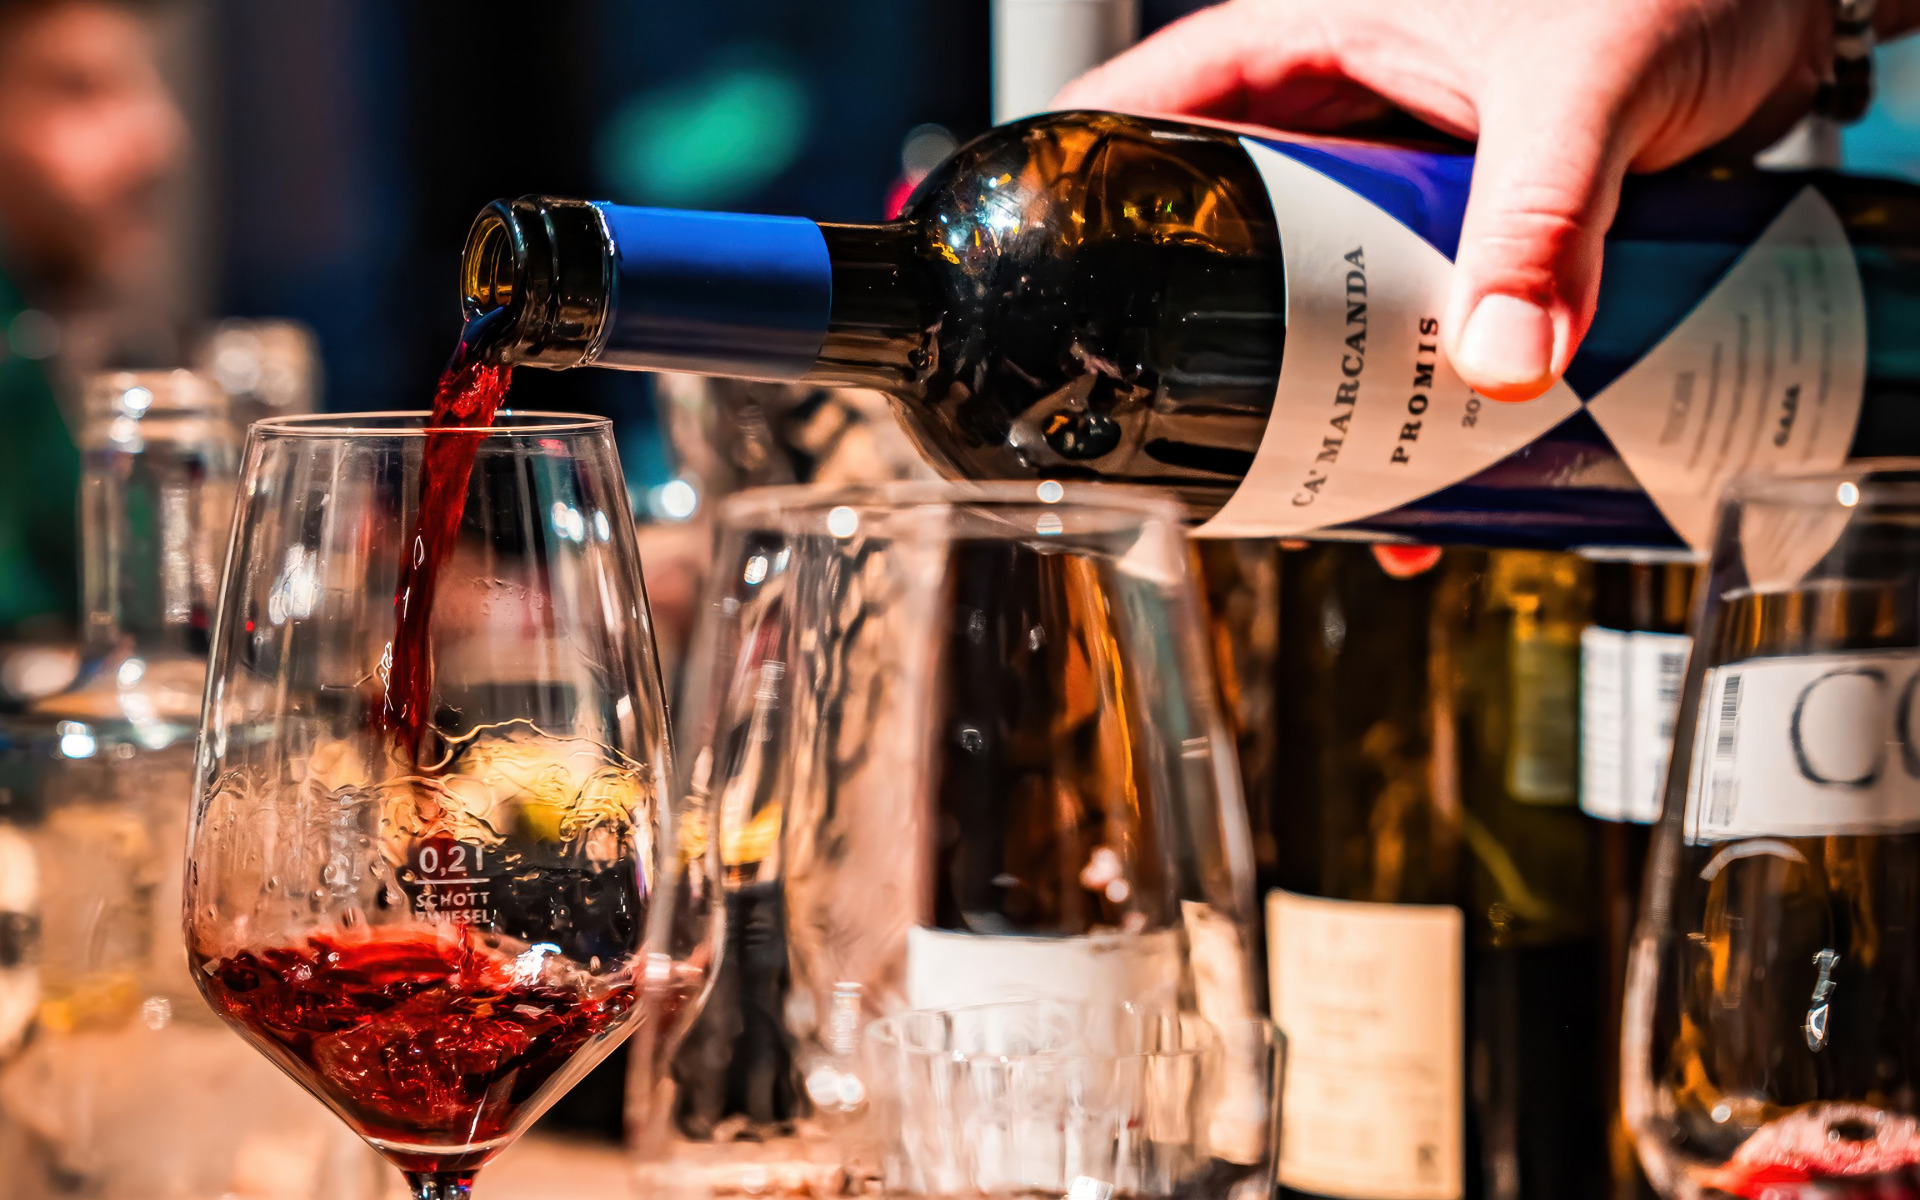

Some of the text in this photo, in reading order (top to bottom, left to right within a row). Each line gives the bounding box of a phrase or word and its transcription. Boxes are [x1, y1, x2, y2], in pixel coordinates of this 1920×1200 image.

[1391, 317, 1439, 466] PROMIS
[1462, 388, 1483, 427] 20
[416, 891, 490, 907] SCHOTT
